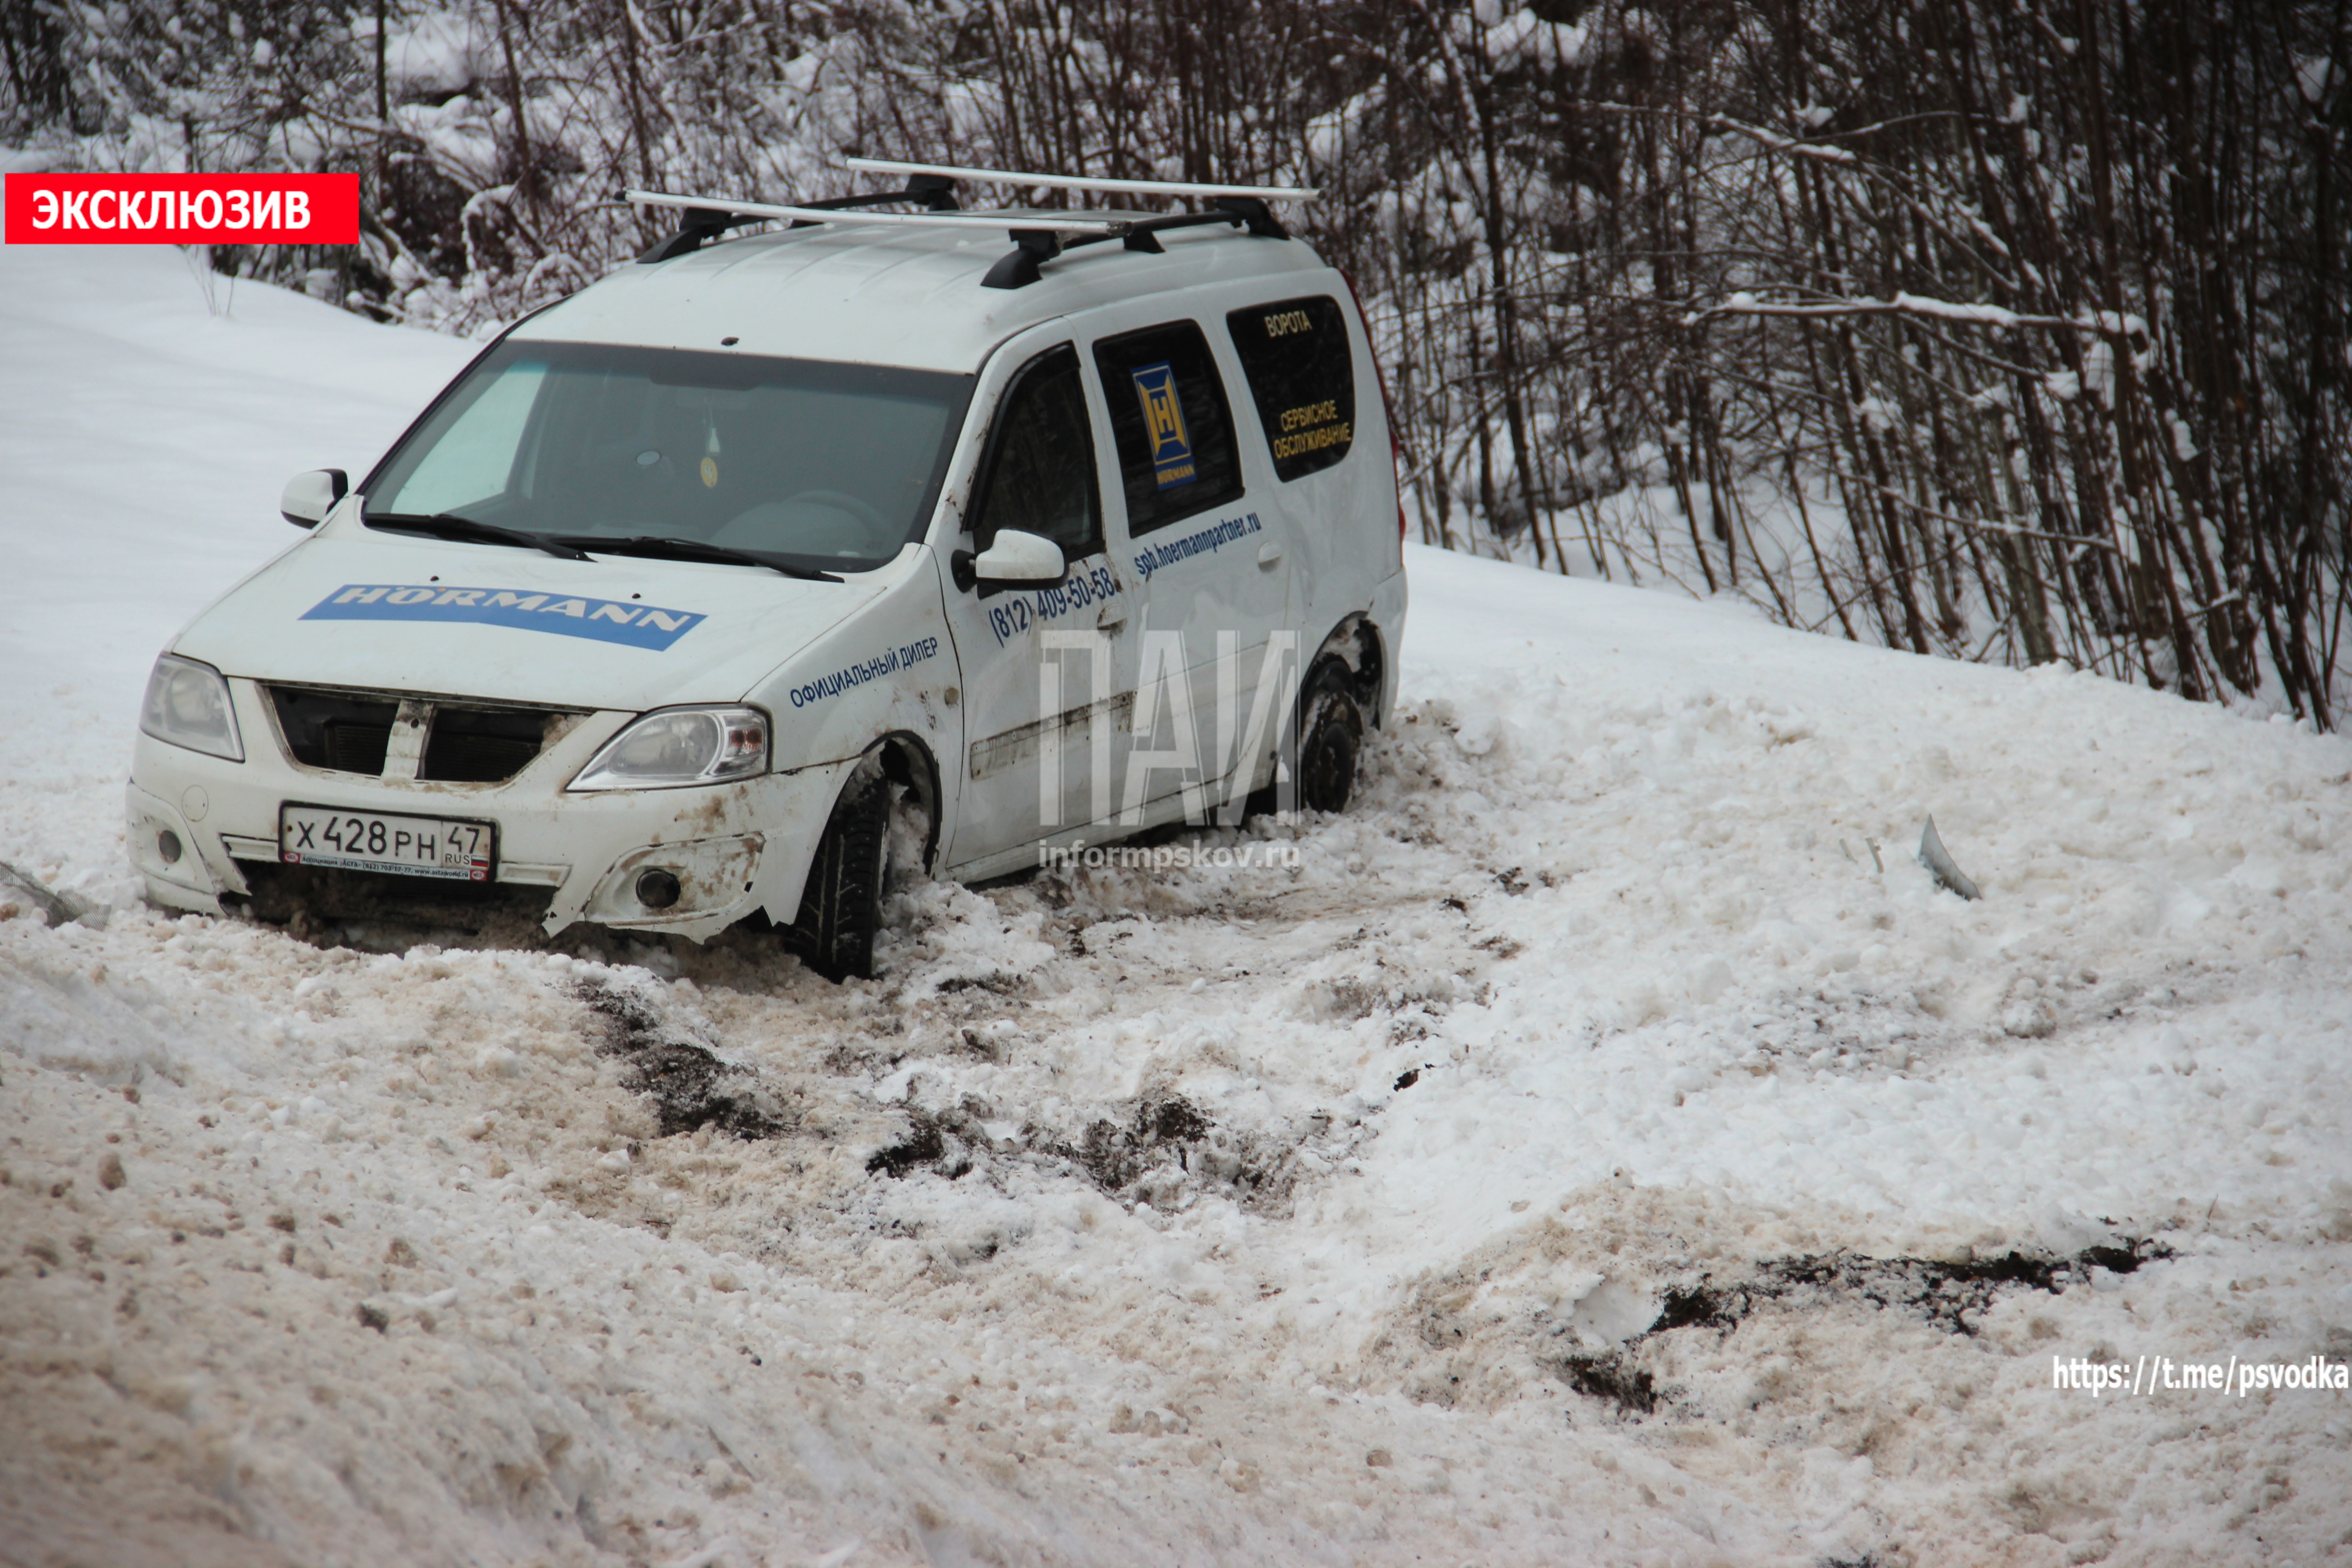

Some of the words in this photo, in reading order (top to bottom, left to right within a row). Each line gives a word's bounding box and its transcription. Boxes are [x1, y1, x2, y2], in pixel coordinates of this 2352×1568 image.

[1265, 310, 1312, 337] ВОРОТА
[1274, 422, 1352, 459] ОБСЛУЖИВАНИЕ
[1135, 512, 1262, 575] spb.hoermannpartner.ru
[989, 596, 1034, 648] (812)
[1037, 567, 1115, 621] 409-50-58
[790, 647, 899, 708] ОФИЦИАЛЬНЫЙ
[899, 637, 938, 671] ДИЛЕР
[448, 826, 480, 854] 47
[363, 862, 379, 871] (812)
[445, 853, 470, 864] RUS
